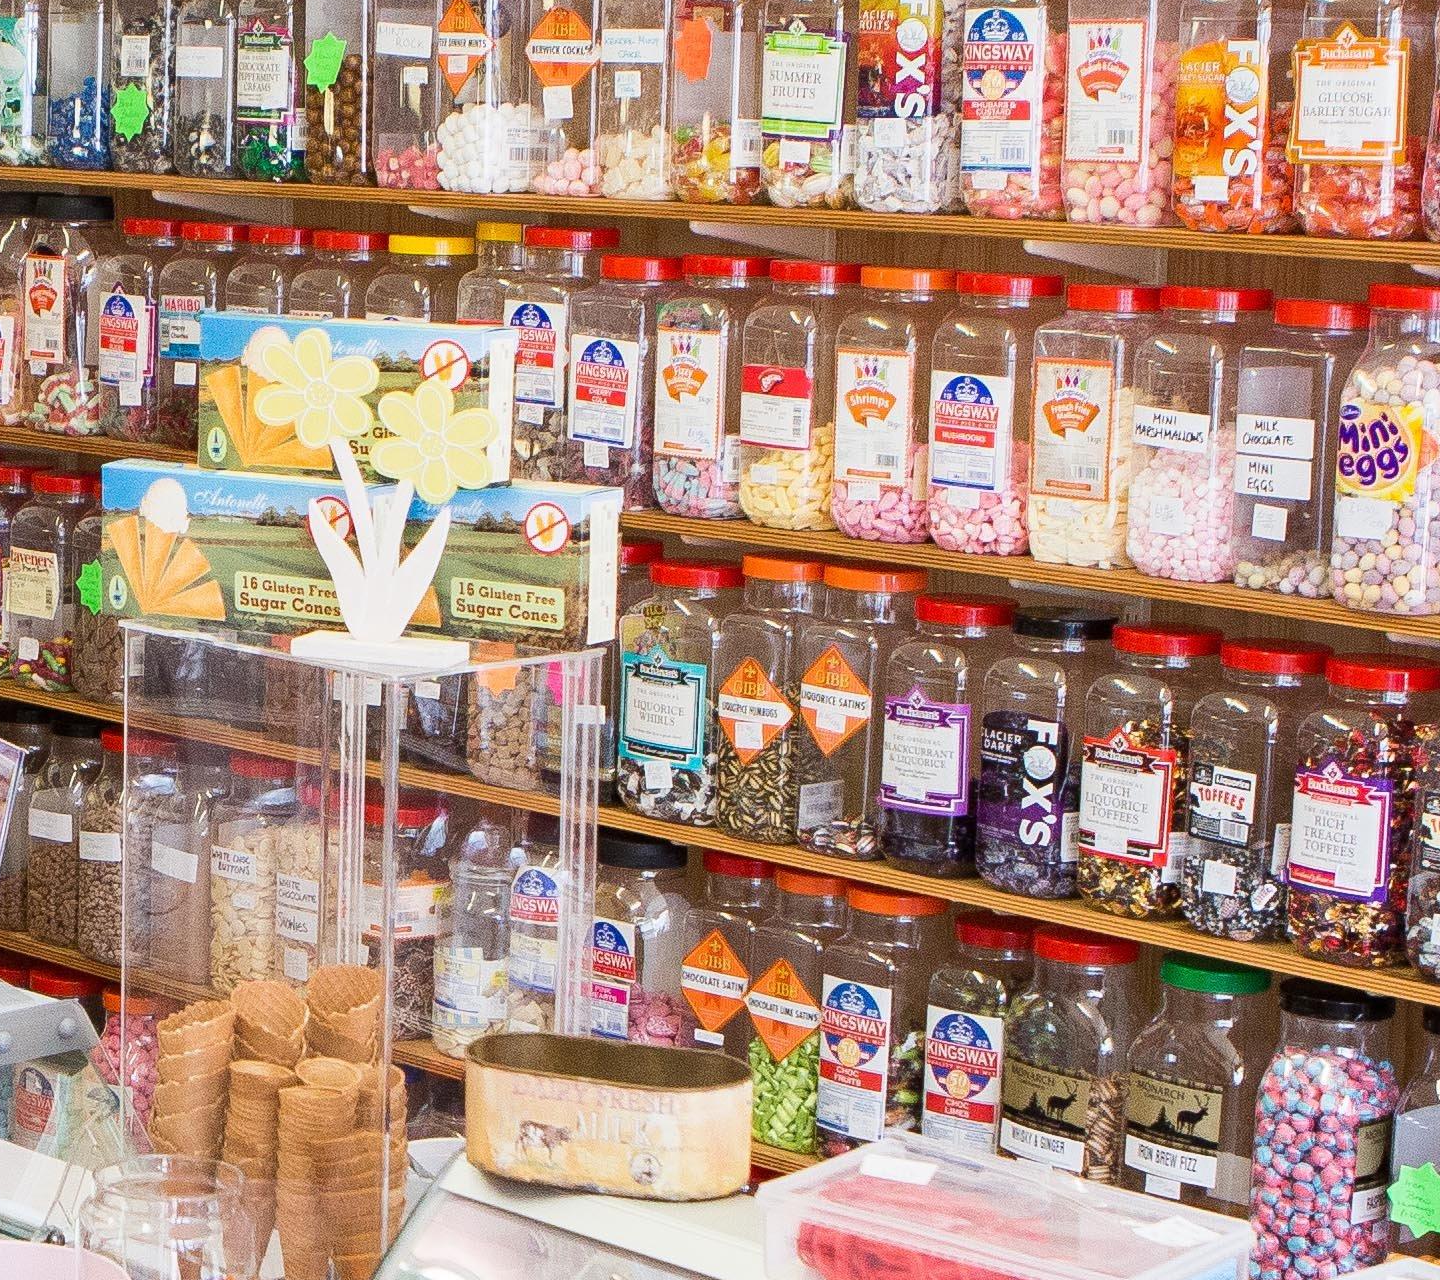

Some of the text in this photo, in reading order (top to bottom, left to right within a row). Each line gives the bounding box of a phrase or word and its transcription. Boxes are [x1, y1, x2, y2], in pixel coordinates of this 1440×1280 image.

[164, 297, 200, 312] HARIBO
[934, 401, 998, 420] KINGSWAY
[1151, 413, 1178, 426] MINI
[1254, 420, 1279, 434] MILK
[1339, 413, 1400, 458] Mini
[1247, 462, 1274, 475] MINI
[1339, 439, 1409, 487] eggs
[239, 593, 341, 617] Sugar Cones
[458, 581, 556, 605] 16 Gluten Free
[456, 598, 558, 624] Sugar Cones
[927, 1040, 997, 1067] KINGSWAY
